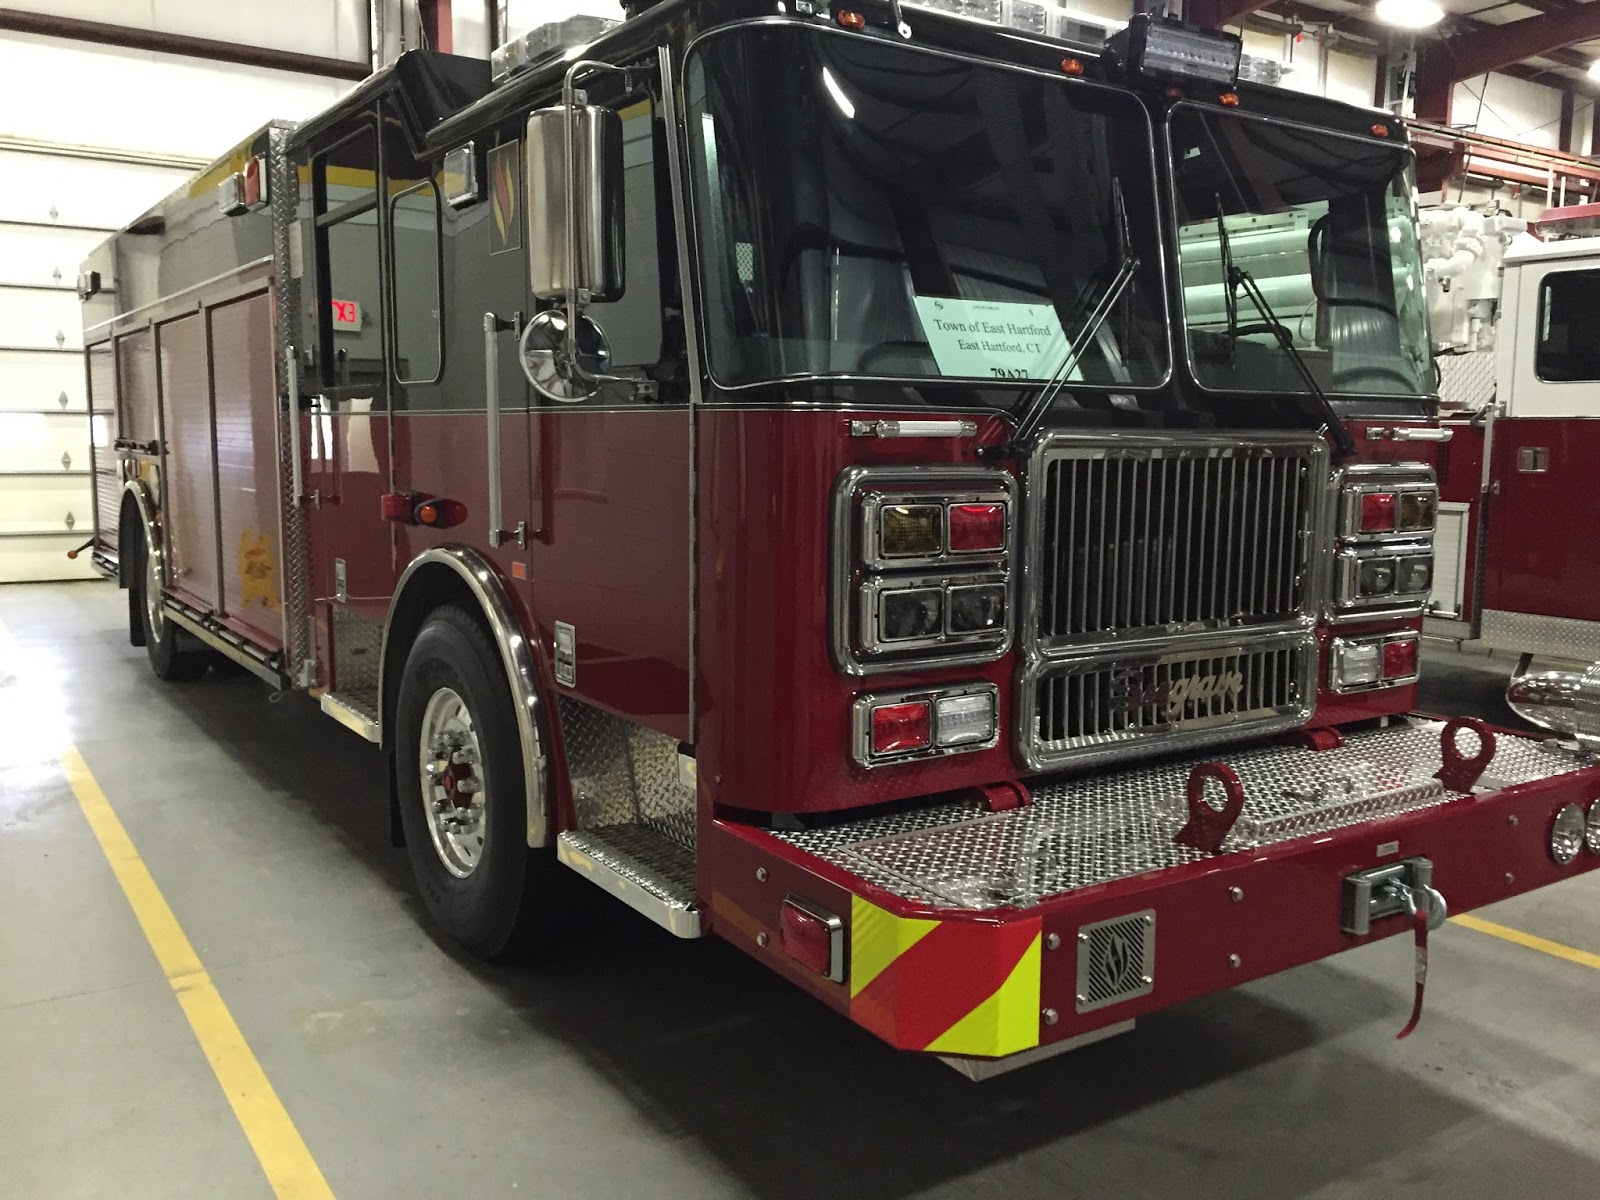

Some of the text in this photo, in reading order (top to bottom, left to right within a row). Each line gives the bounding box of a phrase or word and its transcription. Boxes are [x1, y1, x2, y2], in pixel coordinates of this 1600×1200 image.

[933, 319, 1052, 336] Town of East Hartford
[957, 339, 1042, 355] East Hartford, CT
